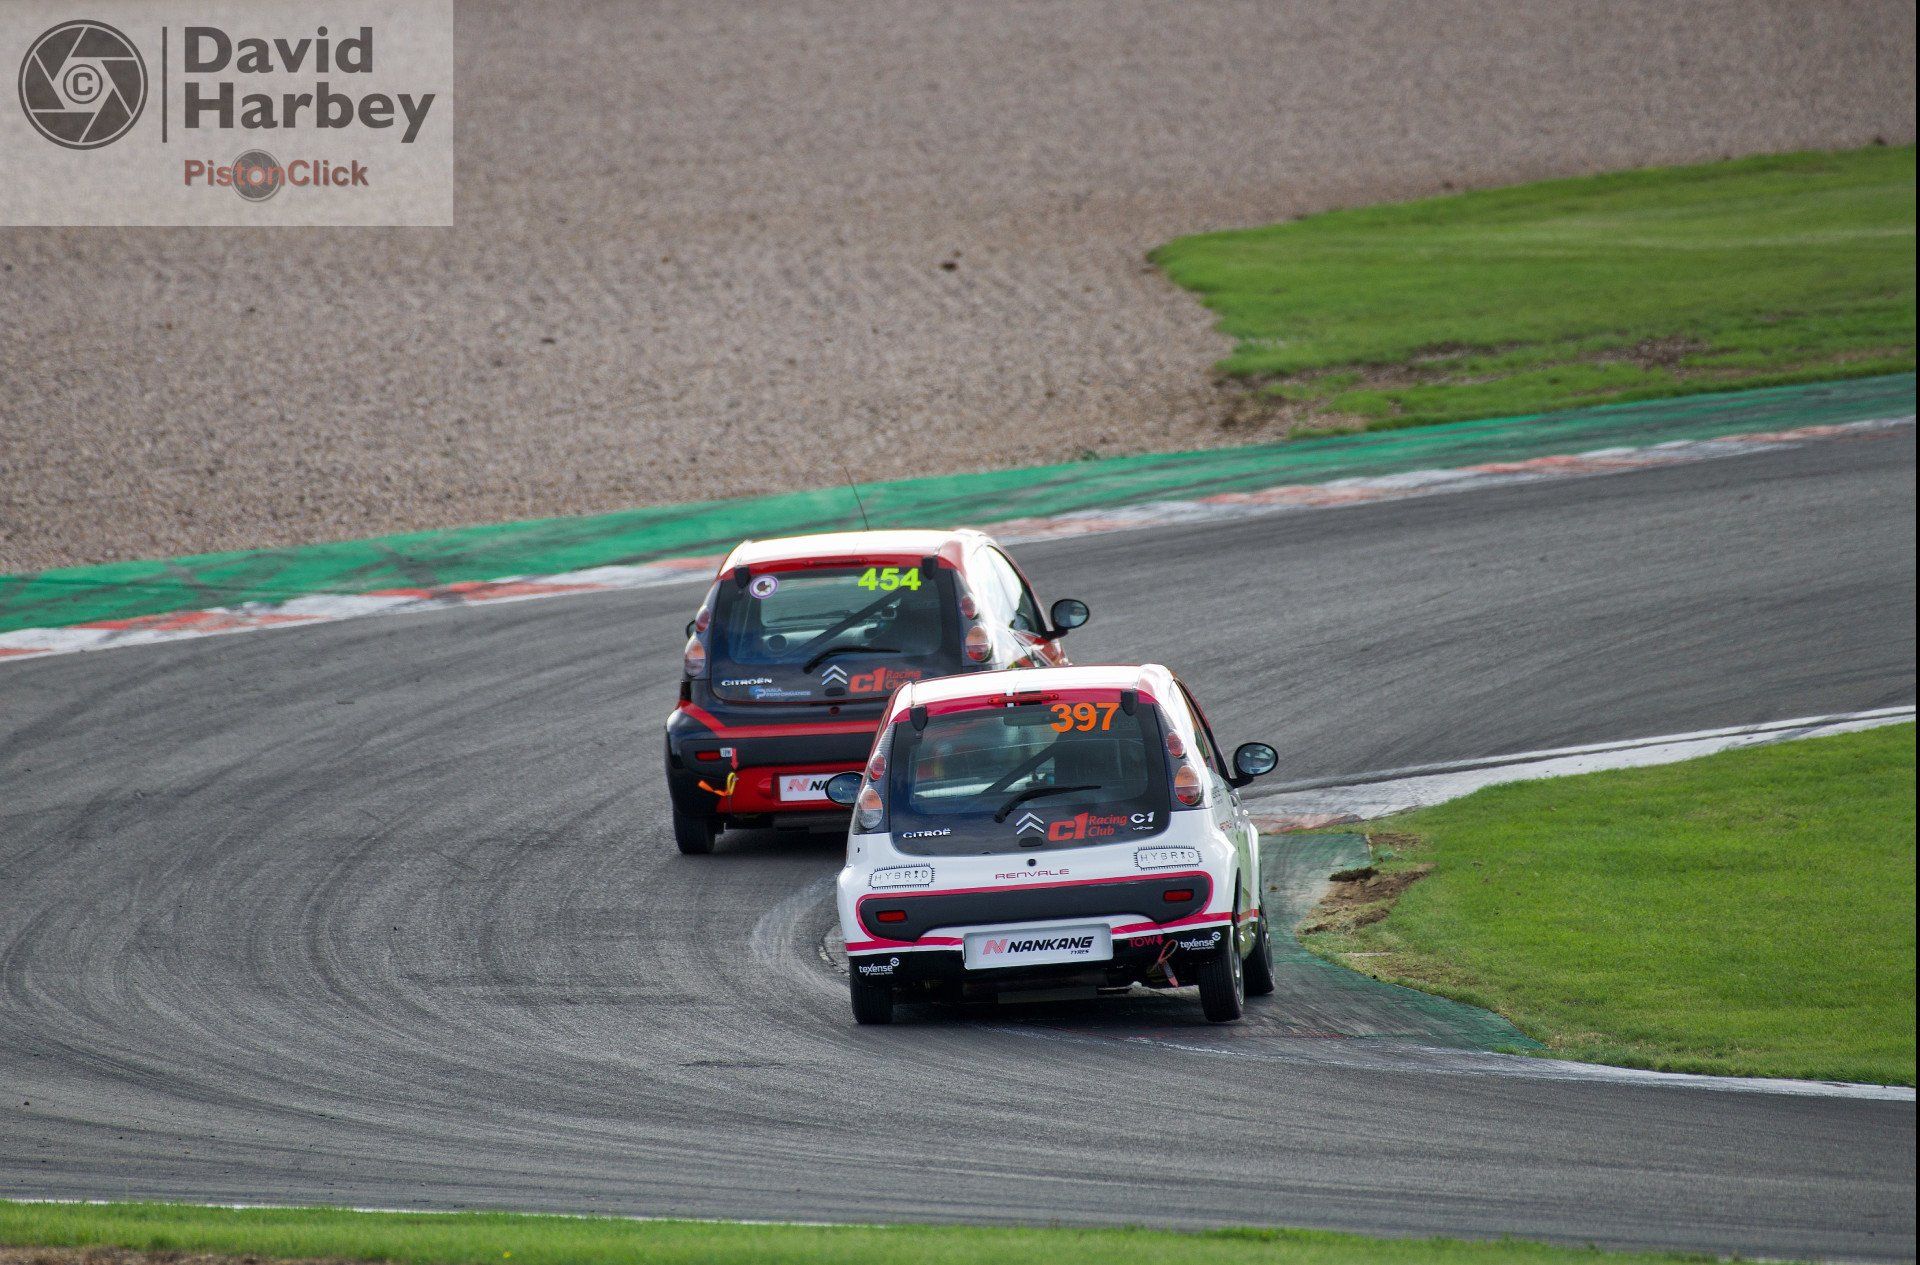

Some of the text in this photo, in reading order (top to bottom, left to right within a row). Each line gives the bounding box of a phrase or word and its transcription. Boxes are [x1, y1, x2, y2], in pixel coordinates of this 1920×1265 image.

[857, 567, 922, 591] 454
[886, 671, 922, 680] Racing
[721, 677, 773, 687] CITROËN
[1050, 702, 1120, 733] 397
[1088, 815, 1128, 826] Racing
[1130, 811, 1155, 824] C1
[902, 828, 951, 839] CITROË
[1088, 826, 1115, 837] Club
[1140, 851, 1195, 862] HYBRID
[874, 870, 929, 882] HYBRID
[995, 868, 1070, 880] RENVALE
[1007, 936, 1095, 954] NANKANG
[1130, 936, 1156, 947] TOW
[1180, 939, 1215, 951] texense
[858, 963, 893, 976] texense
